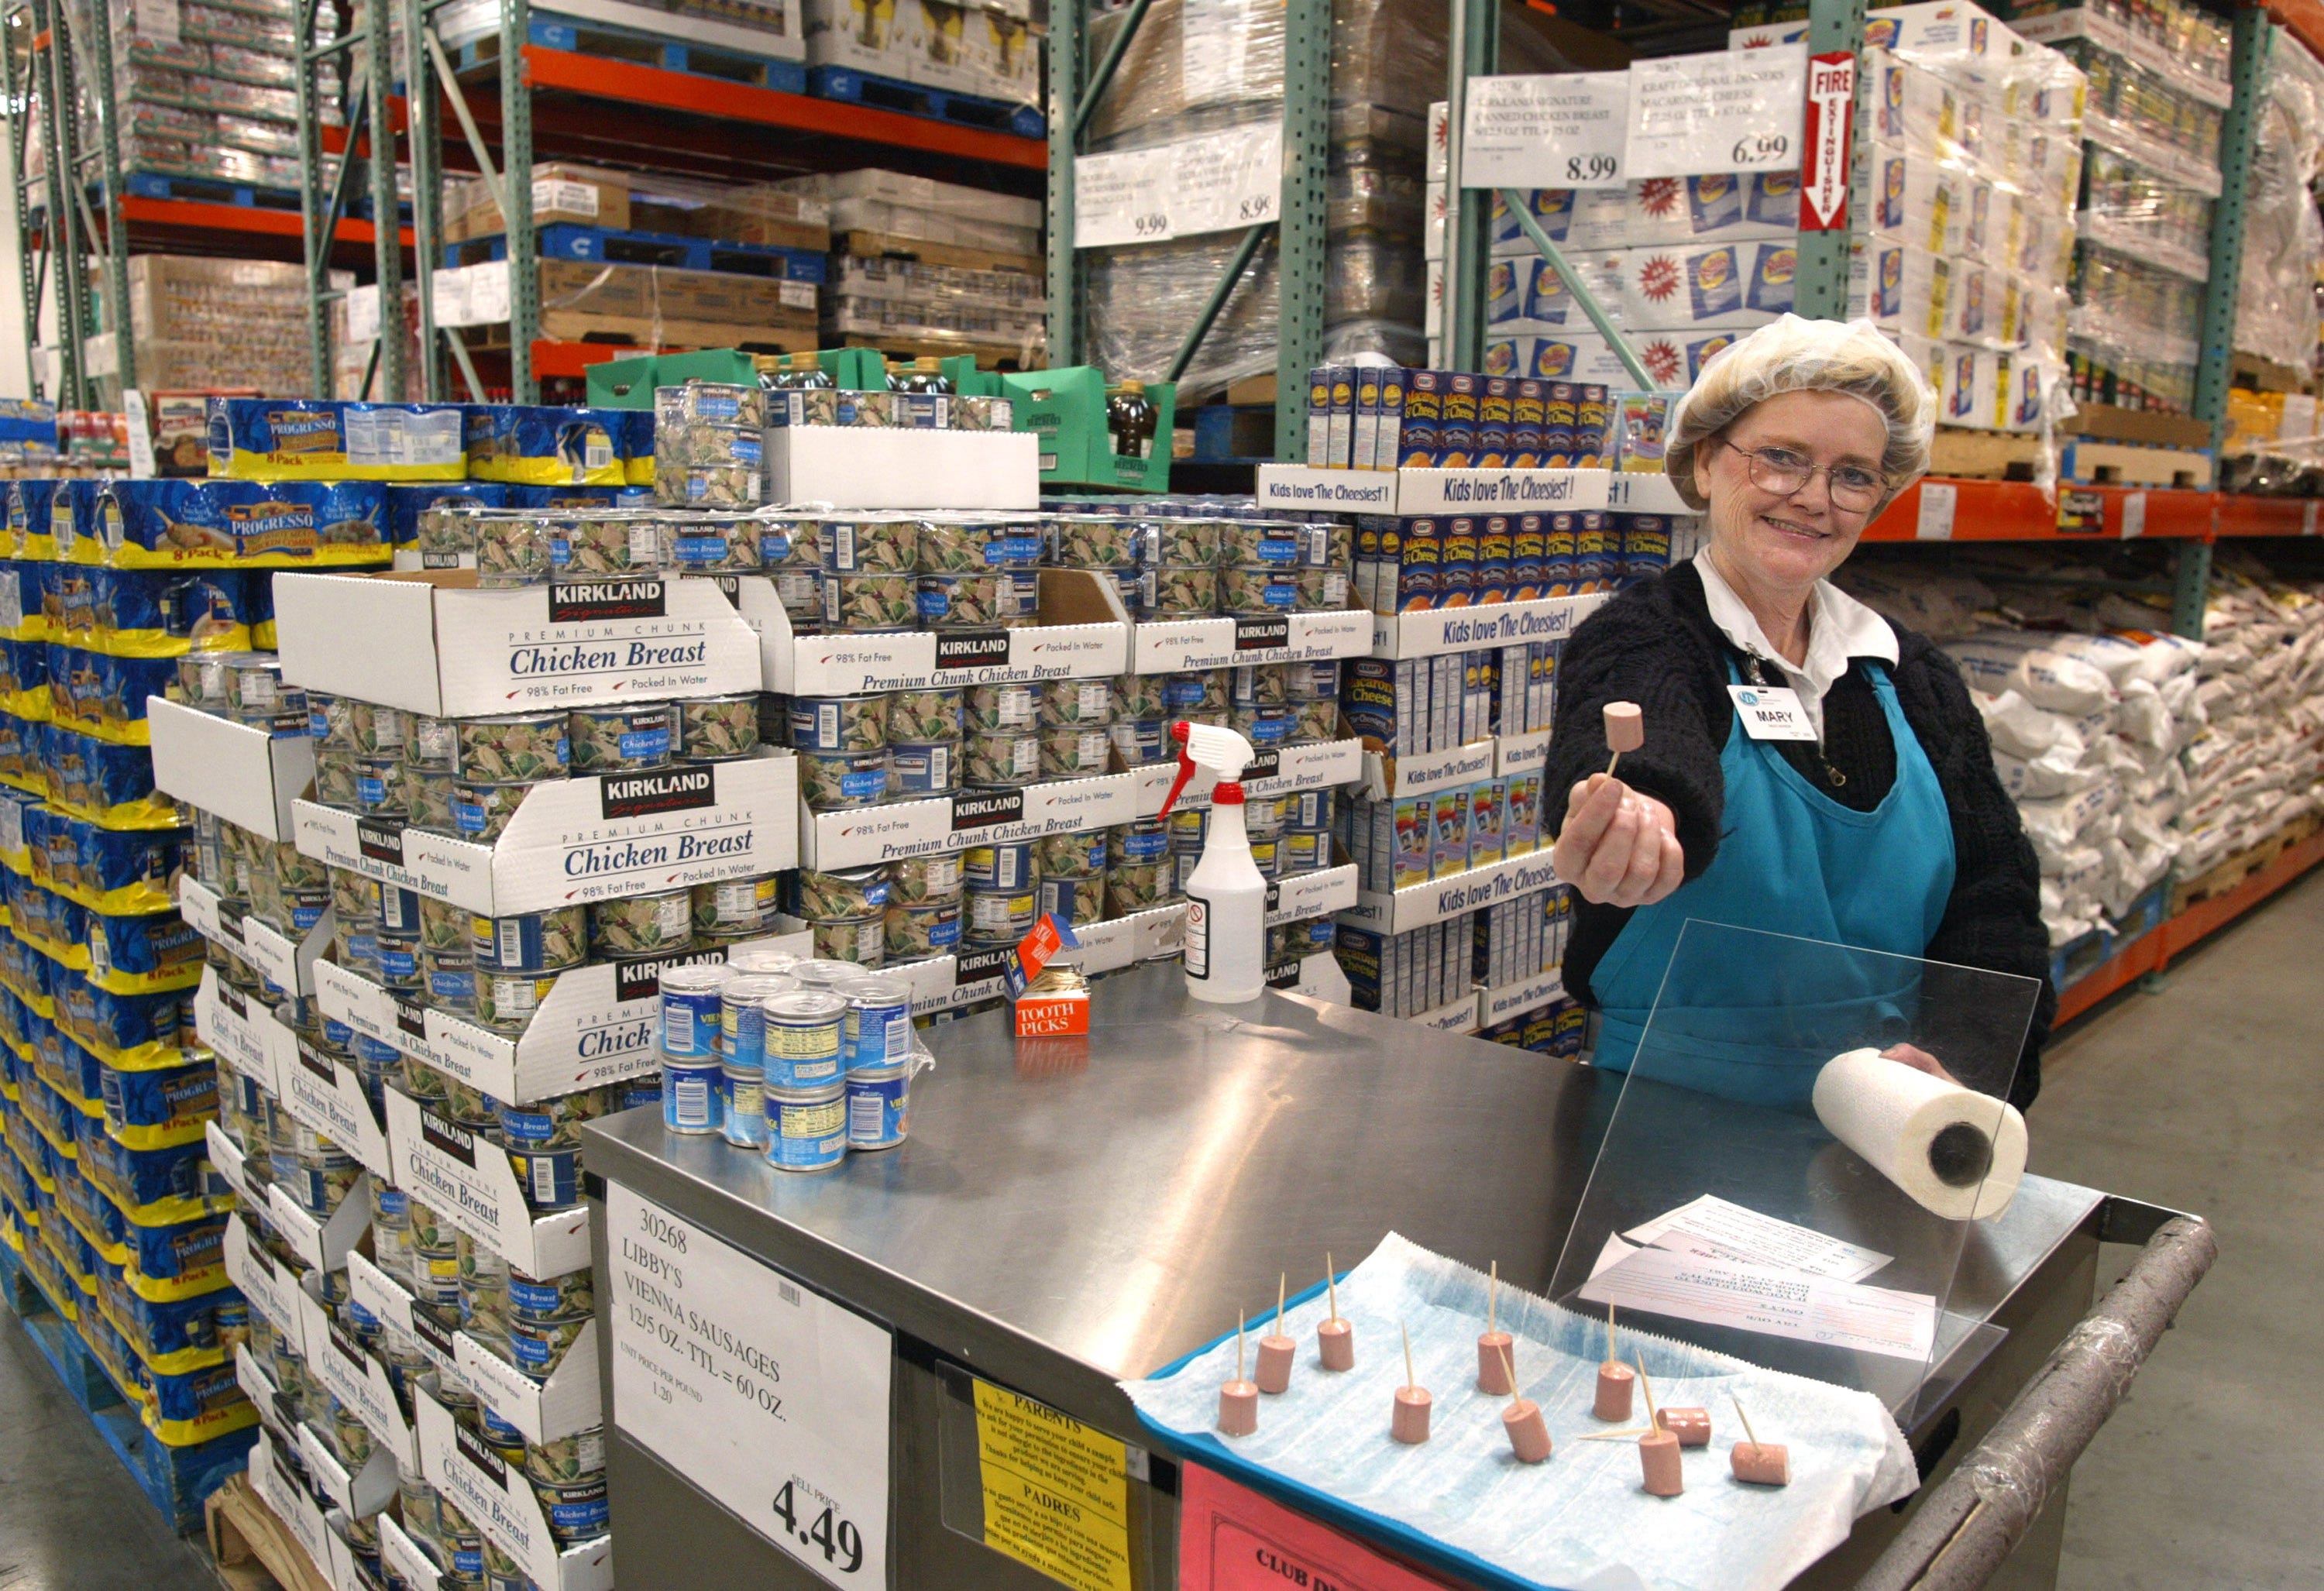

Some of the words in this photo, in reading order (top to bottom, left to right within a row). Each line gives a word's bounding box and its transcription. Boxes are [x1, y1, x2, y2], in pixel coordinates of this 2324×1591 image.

[1816, 70, 1851, 94] FIRE
[1573, 110, 1611, 119] BREAST
[1733, 135, 1788, 163] 6.99
[1823, 98, 1837, 213] EXTINGUISHER
[1566, 156, 1618, 180] 8.99
[1135, 215, 1167, 235] 9.99
[270, 420, 335, 437] PROGRESSO
[266, 454, 273, 462] 8
[276, 455, 303, 466] Pack
[1270, 483, 1291, 497] Kids
[1293, 483, 1313, 498] love
[1315, 482, 1333, 500] The
[1445, 478, 1470, 501] Kids
[1473, 479, 1497, 500] love
[1500, 477, 1520, 501] The
[232, 513, 313, 536] PROGRESSO
[174, 549, 183, 561] 8
[188, 549, 224, 561] Pack
[425, 554, 457, 568] KIRKLAND
[1411, 549, 1438, 564] Cheese
[555, 583, 661, 604] KIRKLAND
[509, 627, 614, 642] PREMIUM
[635, 621, 705, 636] CHUNK
[1239, 625, 1286, 637] KIRKLAND
[1443, 620, 1469, 643] Kids
[1473, 618, 1496, 641] love
[1499, 614, 1518, 637] The
[940, 640, 1007, 655] KIRKLAND
[1046, 641, 1071, 652] Packed
[1074, 641, 1081, 650] In
[1083, 640, 1102, 650] Water
[1184, 654, 1228, 668] Premium
[1232, 651, 1263, 664] Chunk
[1266, 649, 1302, 661] Chicken
[1305, 645, 1332, 657] Breast
[511, 644, 616, 674] Chicken
[627, 641, 705, 667] Breast
[836, 654, 855, 663] 98%
[858, 653, 871, 663] Fat
[874, 653, 892, 662] Free
[862, 673, 925, 690] Premium
[932, 670, 974, 686] Chunk
[978, 666, 1028, 682] Chicken
[1033, 664, 1071, 678] Breast
[1357, 665, 1384, 673] KRAFT
[527, 686, 548, 696] 98%
[552, 684, 569, 695] Fat
[571, 683, 592, 694] Free
[631, 678, 665, 689] Packed
[668, 677, 677, 686] In
[681, 674, 707, 686] Water
[1353, 689, 1393, 707] Cheese
[1756, 710, 1793, 722] MARY
[1507, 749, 1521, 764] Kids
[1523, 747, 1535, 759] love
[1257, 778, 1293, 792] Chicken
[1296, 773, 1323, 787] Breast
[1408, 770, 1425, 785] Kids
[1428, 767, 1442, 779] love
[1444, 765, 1455, 778] The
[608, 773, 709, 801] KIRKLAND
[1058, 796, 1082, 805] Packed
[1093, 791, 1113, 802] Water
[956, 797, 1021, 816] KIRKLAND
[563, 823, 663, 843] PREMIUM
[684, 811, 753, 827] CHUNK
[856, 825, 875, 834] 98%
[877, 823, 890, 833] Fat
[892, 821, 909, 830] Free
[882, 838, 941, 858] Premium
[947, 830, 988, 847] Chunk
[992, 823, 1040, 840] Chicken
[1045, 816, 1083, 833] Breast
[360, 828, 400, 850] KIRKLAND
[565, 845, 669, 876] Chicken
[677, 829, 753, 859] Breast
[326, 846, 357, 869] Premium
[360, 857, 384, 878] Chunk
[387, 865, 418, 888] Chicken
[421, 875, 448, 896] Breast
[583, 886, 604, 898] 98%
[608, 884, 623, 895] Fat
[625, 881, 645, 891] Free
[683, 870, 714, 882] Packed
[718, 868, 725, 877] In
[729, 864, 755, 875] Water
[1439, 892, 1464, 915] Kids
[1468, 885, 1490, 905] love
[1494, 874, 1513, 898] The
[1515, 864, 1556, 892] Cheesies
[1294, 902, 1322, 917] Breast
[147, 971, 156, 981] 8
[157, 967, 187, 978] Pack
[952, 985, 993, 1002] Chunk
[1018, 1002, 1074, 1022] TOOTH
[1493, 998, 1507, 1014] Kids
[348, 1008, 380, 1034] Premium
[1021, 1018, 1069, 1036] PICKS
[579, 1022, 651, 1057] Chick
[410, 1036, 442, 1064] Chicken
[445, 1053, 471, 1078] Breast
[594, 1066, 615, 1077] 98%
[619, 1064, 631, 1074] Fat
[634, 1058, 655, 1069] Free
[292, 1076, 326, 1115] Chicken
[329, 1102, 358, 1137] Breast
[171, 1116, 201, 1128] Pack
[423, 1110, 472, 1149] KIRKLAND
[410, 1153, 456, 1198] Chicken
[460, 1183, 499, 1226] Breast
[640, 1208, 687, 1255] 30268
[624, 1237, 683, 1289] LIBBY'S
[624, 1271, 684, 1325] VIENNA
[689, 1311, 781, 1383] SAUSAGES
[621, 1342, 638, 1362] UNIT
[638, 1353, 659, 1374] PRICE
[660, 1367, 673, 1386] PER
[675, 1374, 703, 1403] POUND
[628, 1304, 655, 1335] 12/5
[658, 1327, 684, 1355] OZ.
[687, 1340, 718, 1377] TTL
[723, 1370, 732, 1383] =
[736, 1374, 755, 1400] 60
[758, 1393, 786, 1422] OZ.
[652, 1382, 672, 1404] 1.20
[1014, 1395, 1081, 1433] PARENTS
[457, 1424, 504, 1475] KIRKLAND
[562, 1486, 605, 1500] KIRKLAND
[792, 1473, 813, 1497] SELL
[814, 1486, 841, 1514] PRICE
[1024, 1484, 1081, 1523] PADRES
[444, 1459, 487, 1511] Chicken
[492, 1501, 529, 1550] Breast
[554, 1507, 589, 1519] Chicken
[773, 1480, 863, 1573] 4.49
[1257, 1550, 1308, 1586] CLUB
